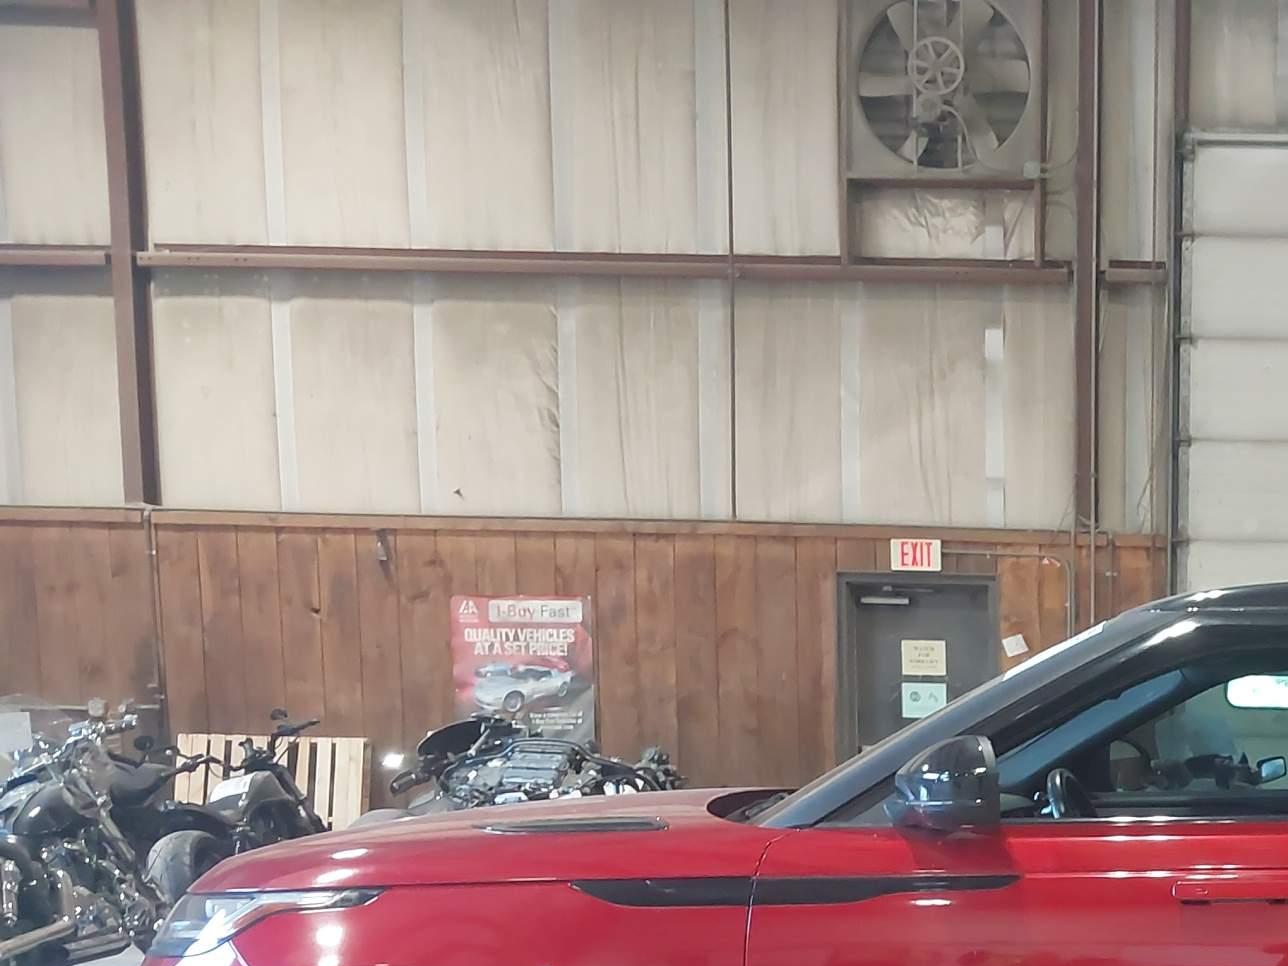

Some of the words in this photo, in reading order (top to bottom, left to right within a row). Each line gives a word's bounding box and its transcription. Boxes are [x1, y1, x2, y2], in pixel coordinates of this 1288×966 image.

[901, 541, 933, 567] EXIT
[540, 604, 570, 618] Fast
[464, 628, 517, 642] QUALITY
[517, 628, 575, 643] VEHICLES
[474, 642, 492, 655] AT
[493, 642, 502, 655] A
[504, 642, 527, 656] SET
[529, 642, 568, 656] PRICE!
